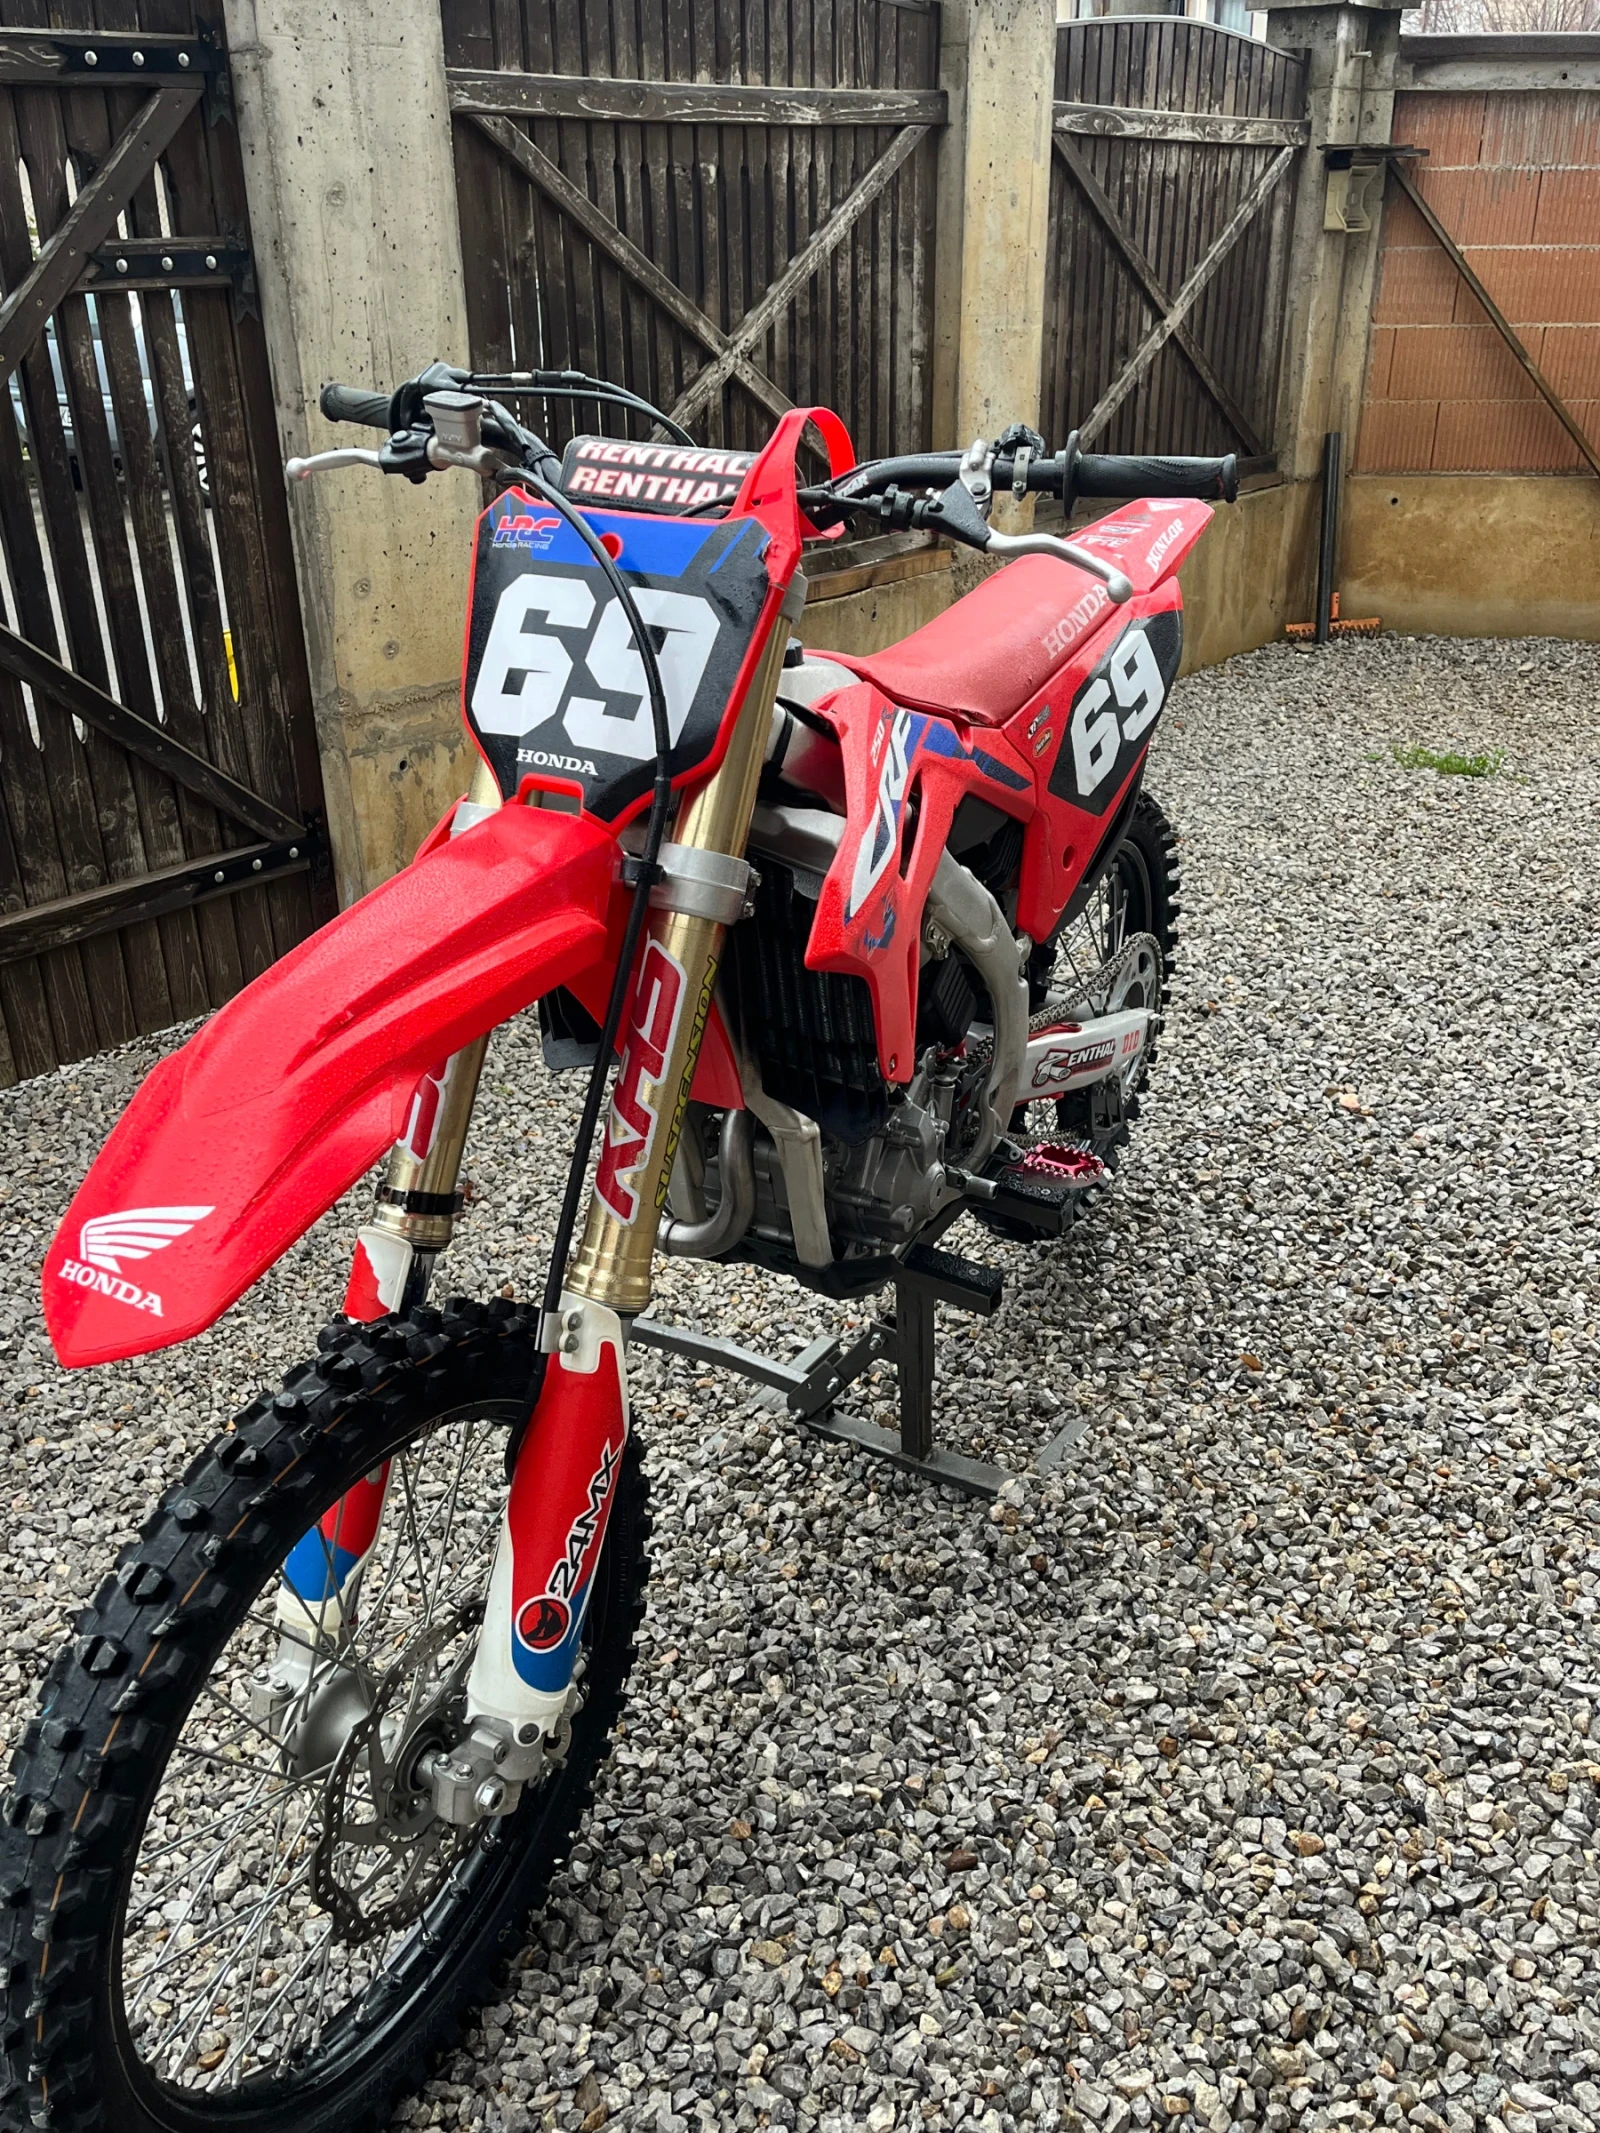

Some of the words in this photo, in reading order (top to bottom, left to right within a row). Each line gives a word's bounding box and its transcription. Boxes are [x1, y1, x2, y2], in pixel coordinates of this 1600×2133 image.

[576, 441, 748, 476] RENTHAL
[493, 515, 562, 544] HRC
[517, 541, 549, 550] RACING
[1145, 518, 1185, 574] DUNLOP
[1041, 583, 1109, 660] HONDA
[471, 574, 720, 761] 69
[1071, 630, 1165, 796] 69
[515, 748, 599, 776] HONDA
[1122, 1030, 1140, 1054] DID
[655, 956, 718, 1209] SUSPENSION
[58, 1259, 164, 1318] HONDA
[545, 1437, 625, 1599] 24MX
